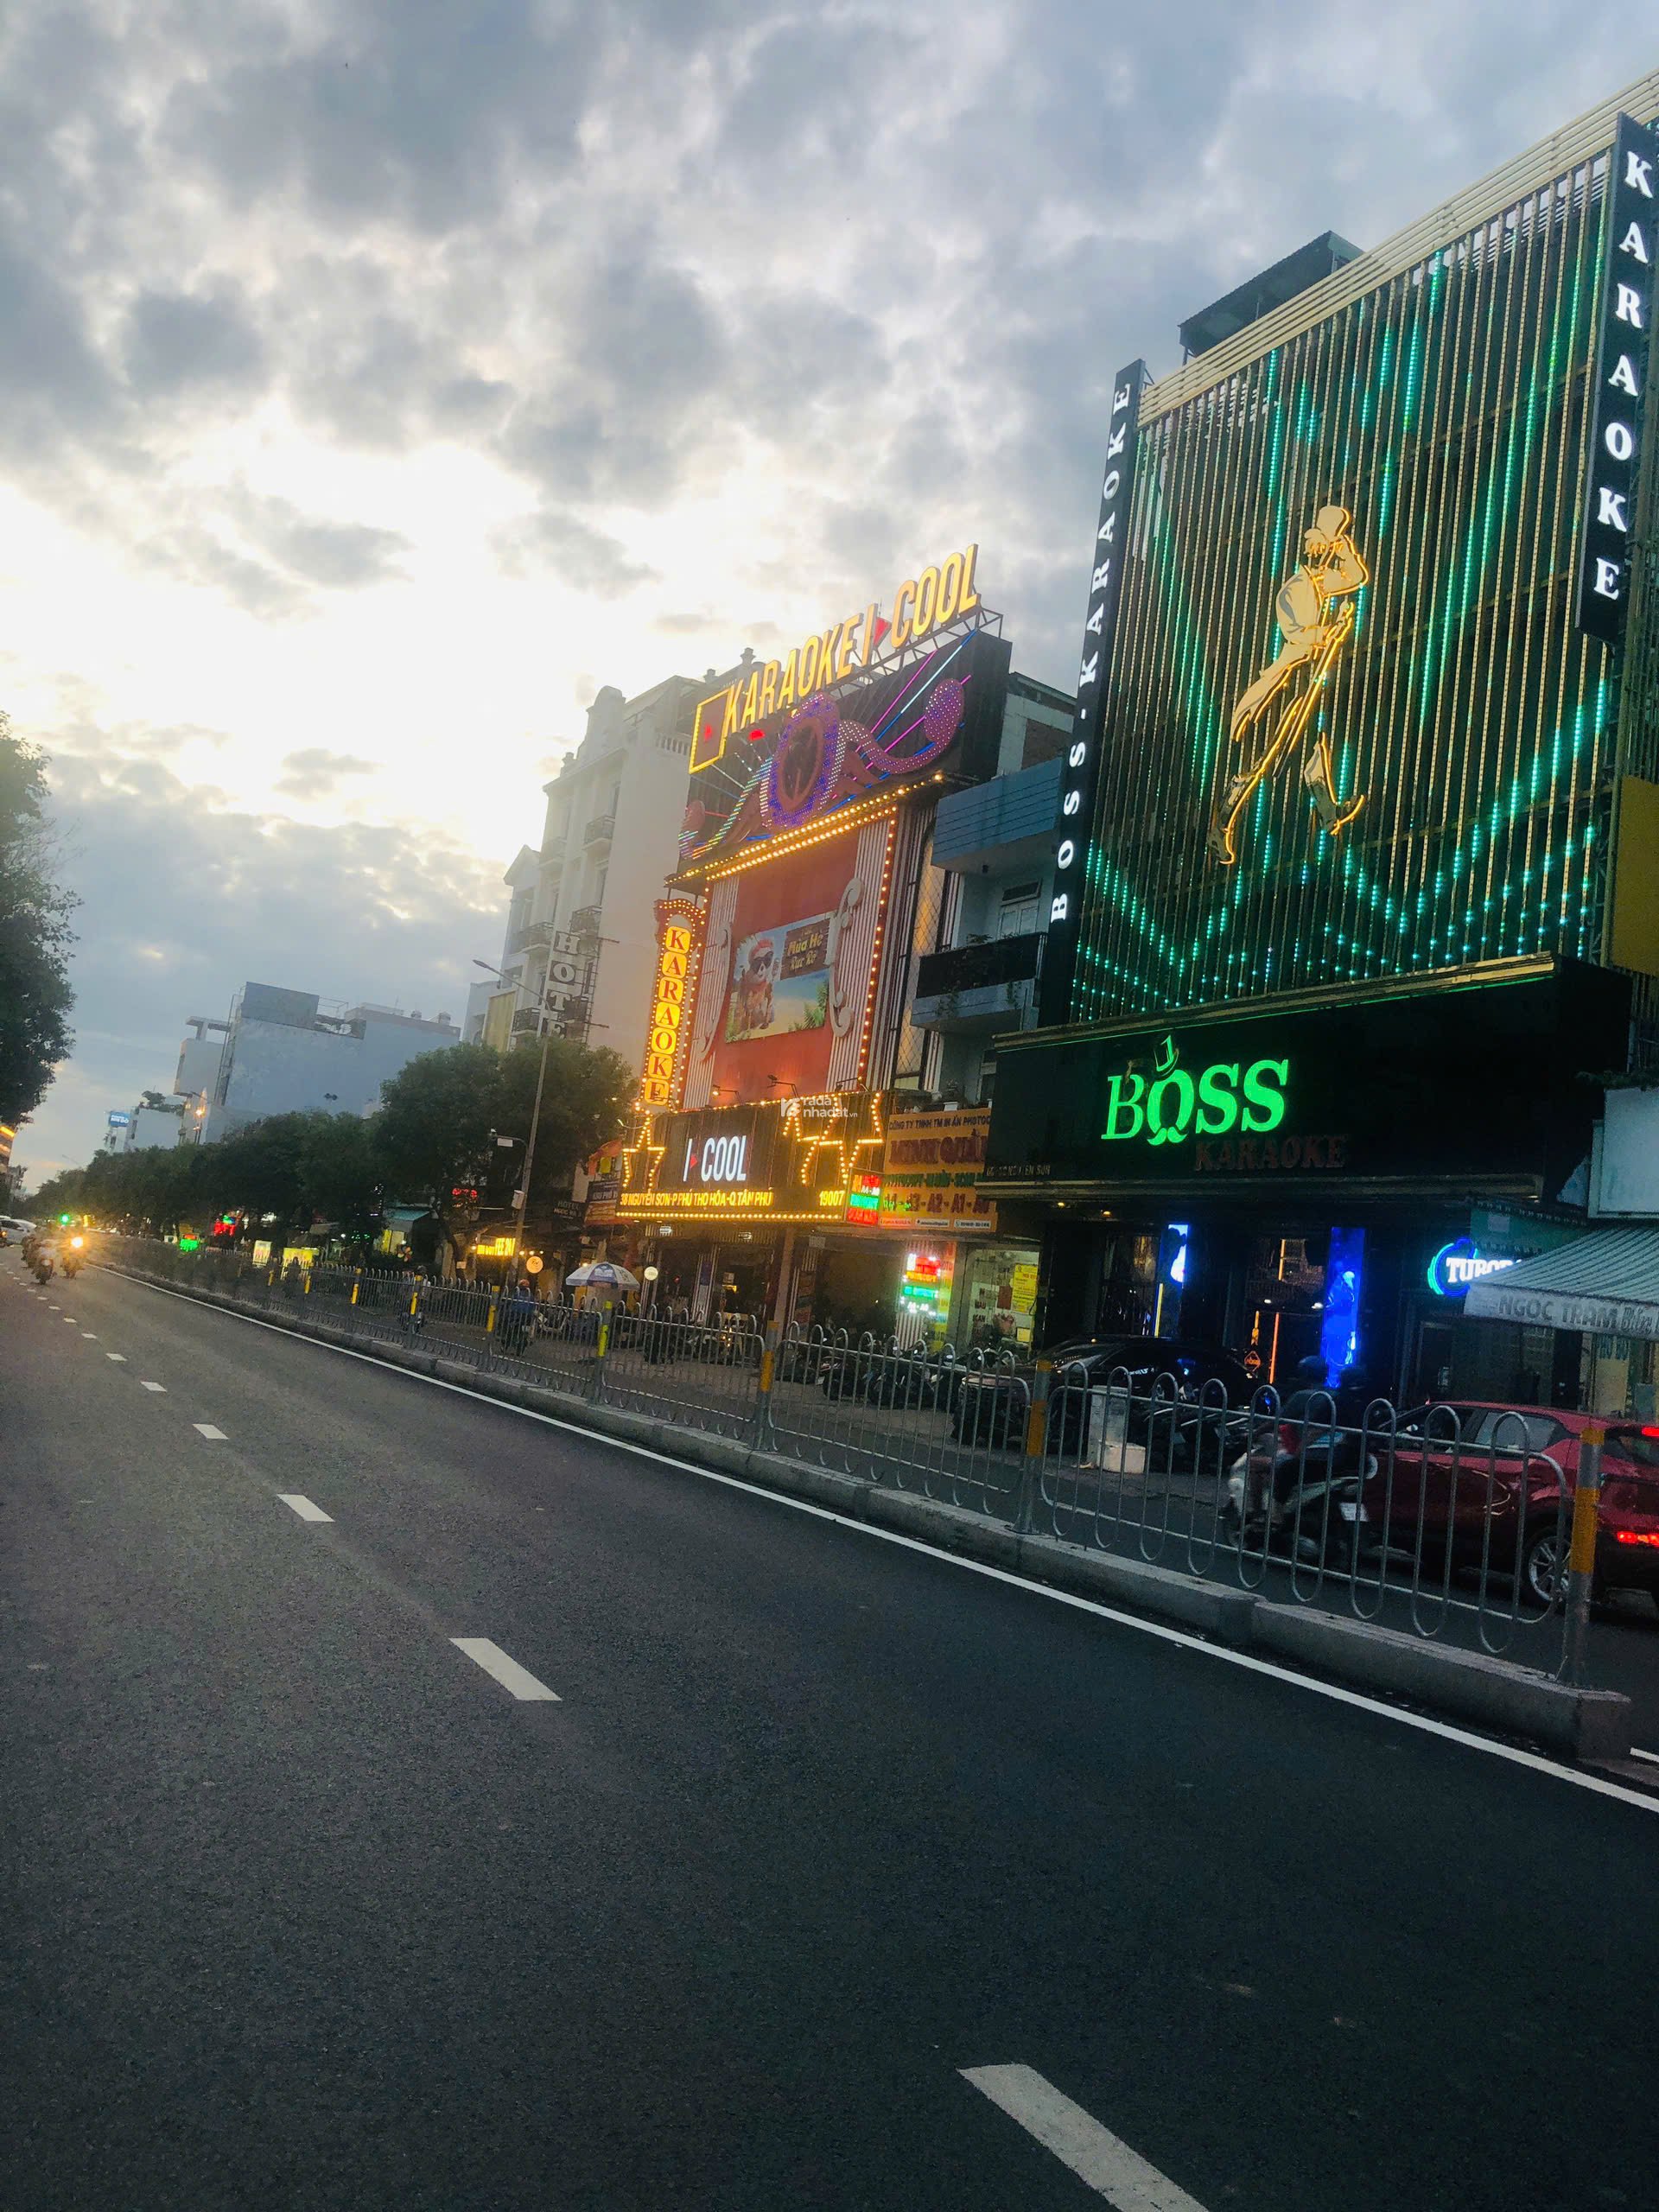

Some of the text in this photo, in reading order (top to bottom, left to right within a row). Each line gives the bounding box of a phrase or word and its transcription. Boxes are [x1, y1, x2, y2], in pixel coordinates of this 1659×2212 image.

[1594, 150, 1654, 601] KARAOKE
[724, 612, 863, 734] KARAOKE
[891, 543, 982, 650] COOL
[1050, 741, 1086, 924] BOSS
[1079, 382, 1131, 689] KARAOKE
[649, 929, 689, 1102] KARAOKE
[1101, 1058, 1288, 1146] BOSS
[701, 1135, 747, 1182] COOL
[1195, 1134, 1350, 1172] KARAOKE
